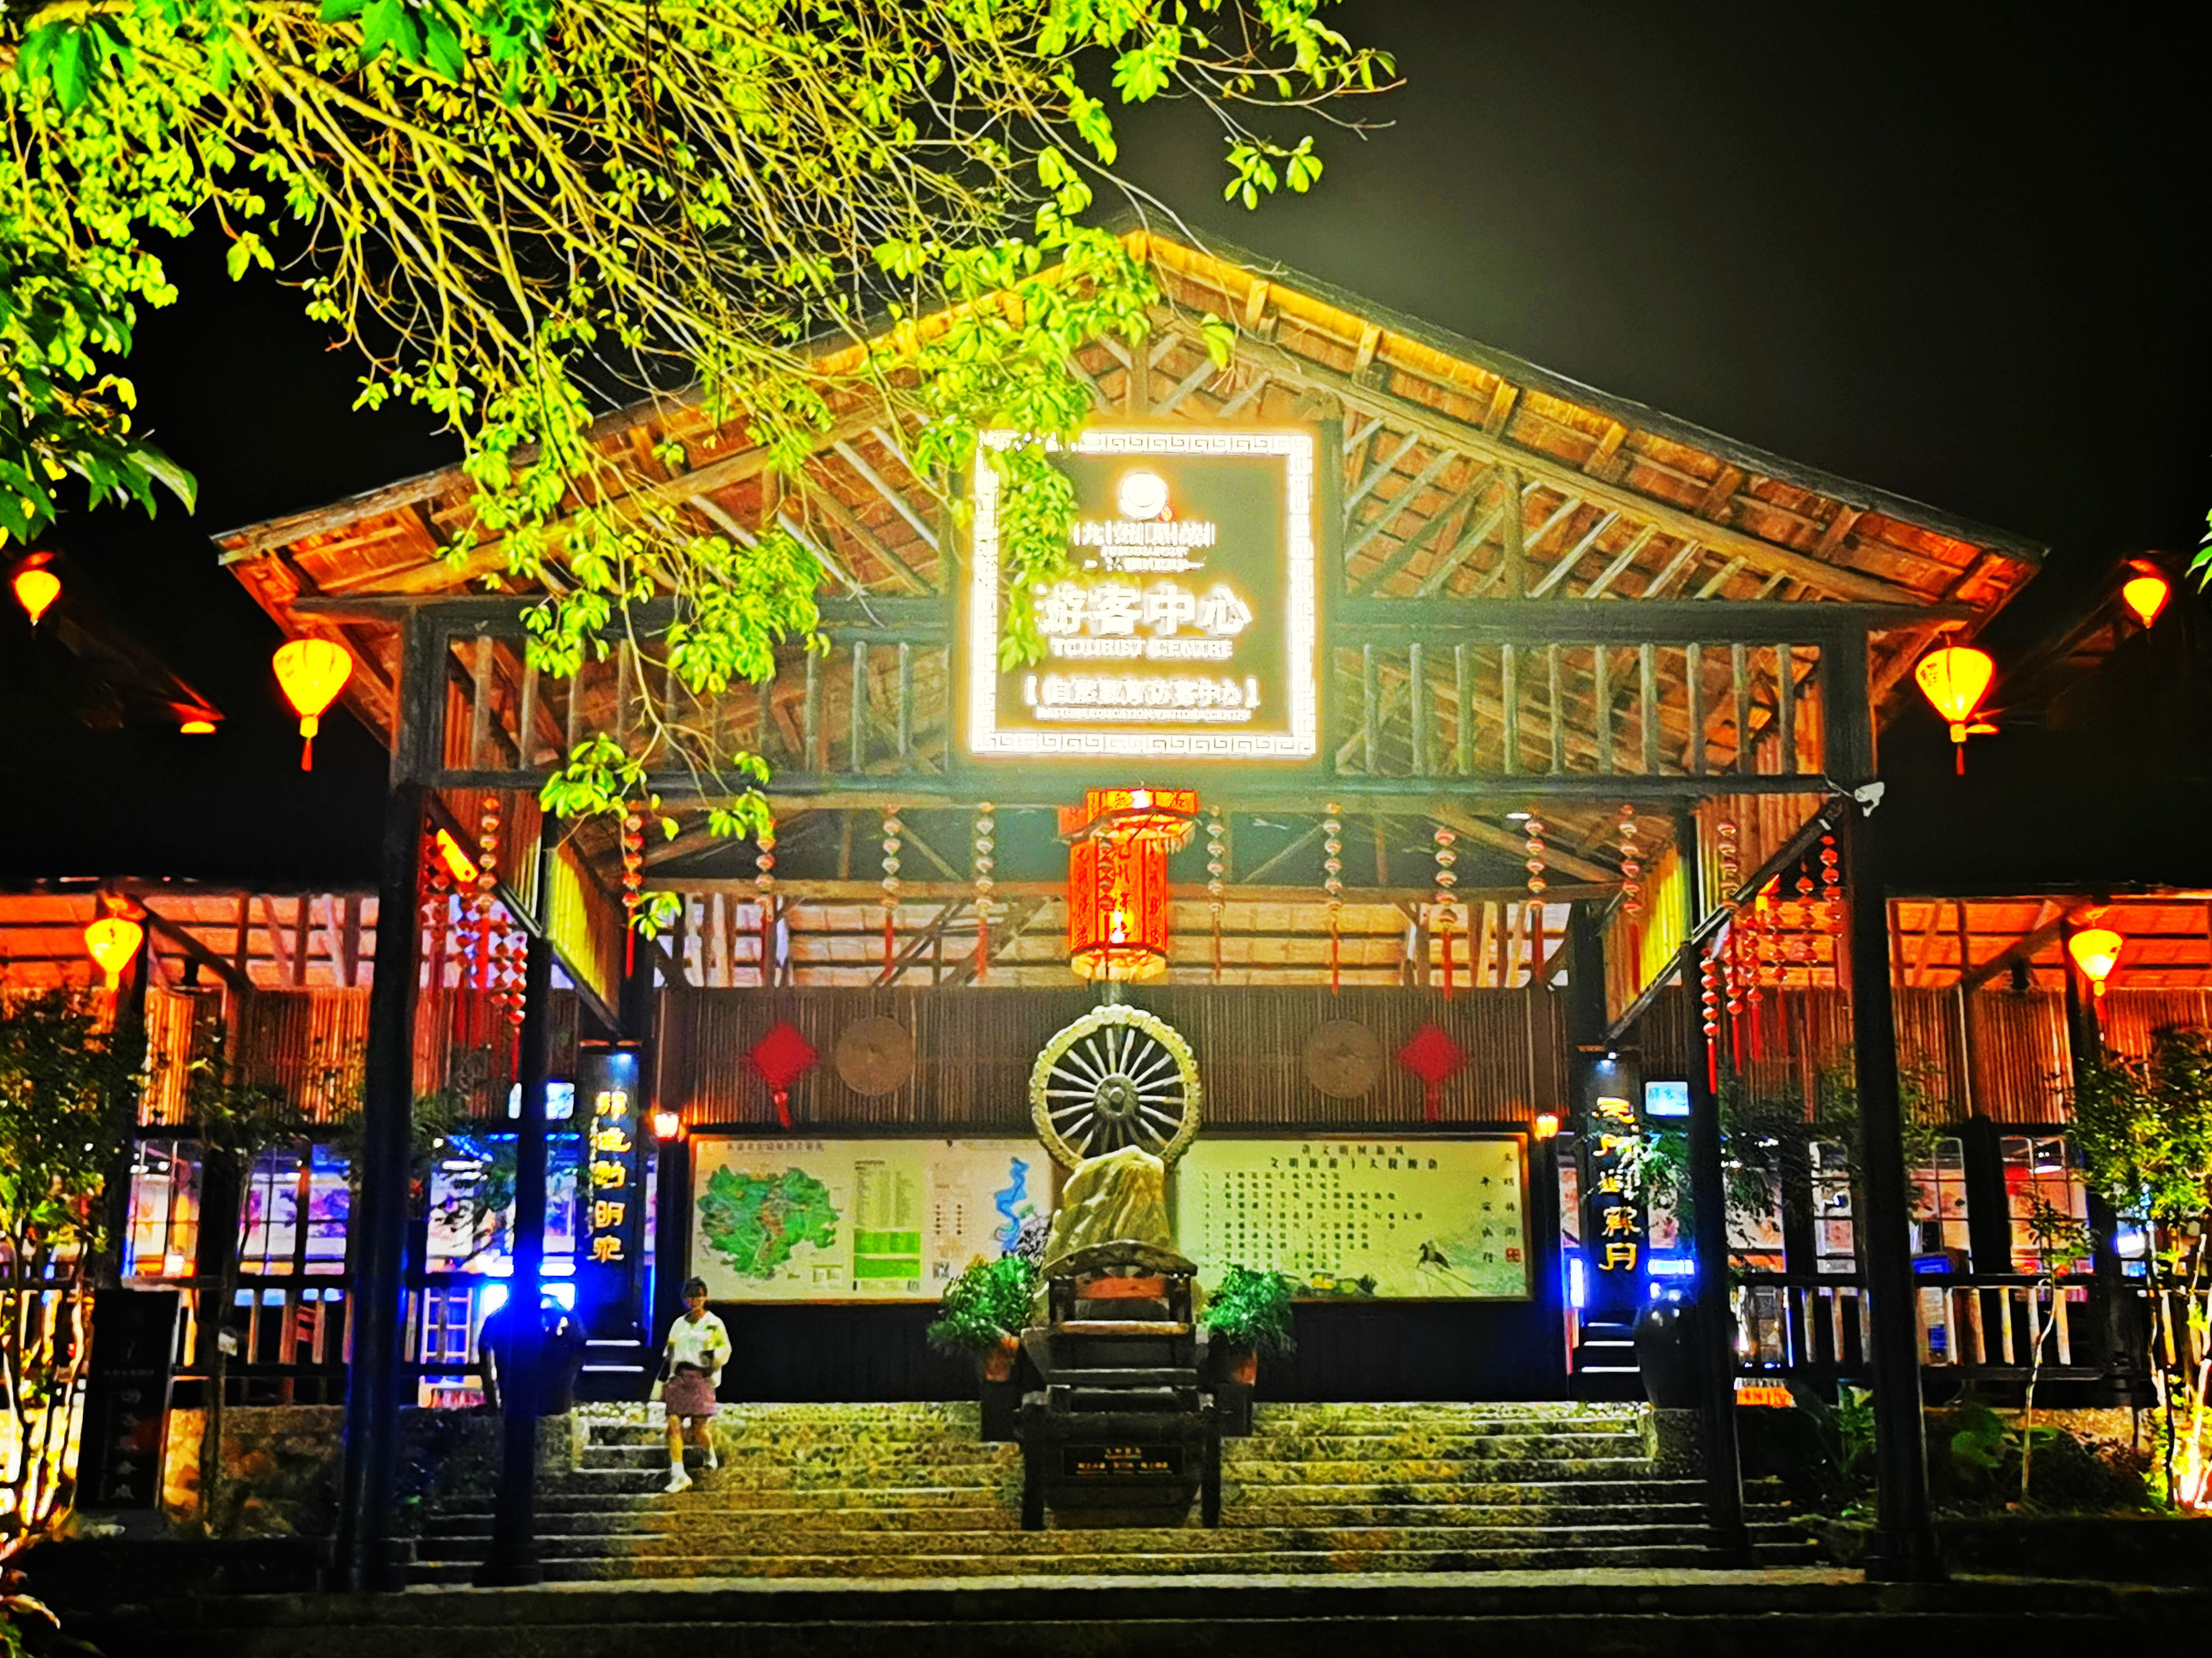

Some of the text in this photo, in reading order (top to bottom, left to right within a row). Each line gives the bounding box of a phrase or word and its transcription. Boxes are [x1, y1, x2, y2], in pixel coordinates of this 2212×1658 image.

[1036, 583, 1252, 635] 游客中心
[1051, 637, 1233, 659] TOURIST CENTRE
